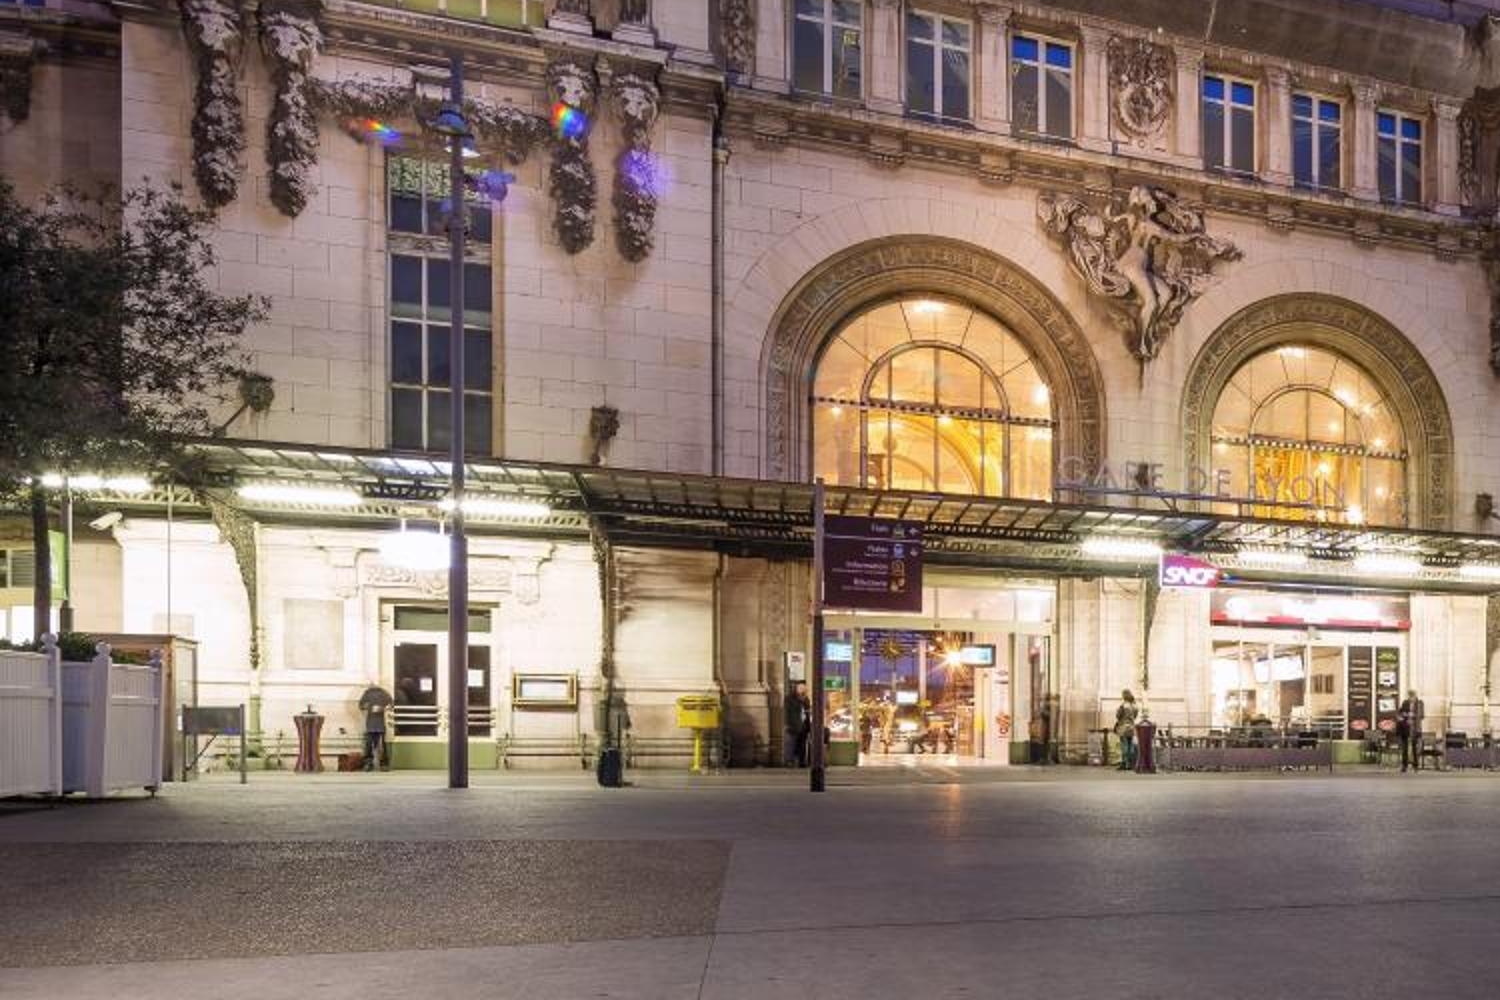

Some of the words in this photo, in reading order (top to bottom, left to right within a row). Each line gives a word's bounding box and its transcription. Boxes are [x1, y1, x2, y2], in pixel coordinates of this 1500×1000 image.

[1058, 456, 1164, 490] GARE
[1187, 465, 1231, 497] DE
[1250, 471, 1345, 509] LYON
[1165, 566, 1217, 584] SNCF
